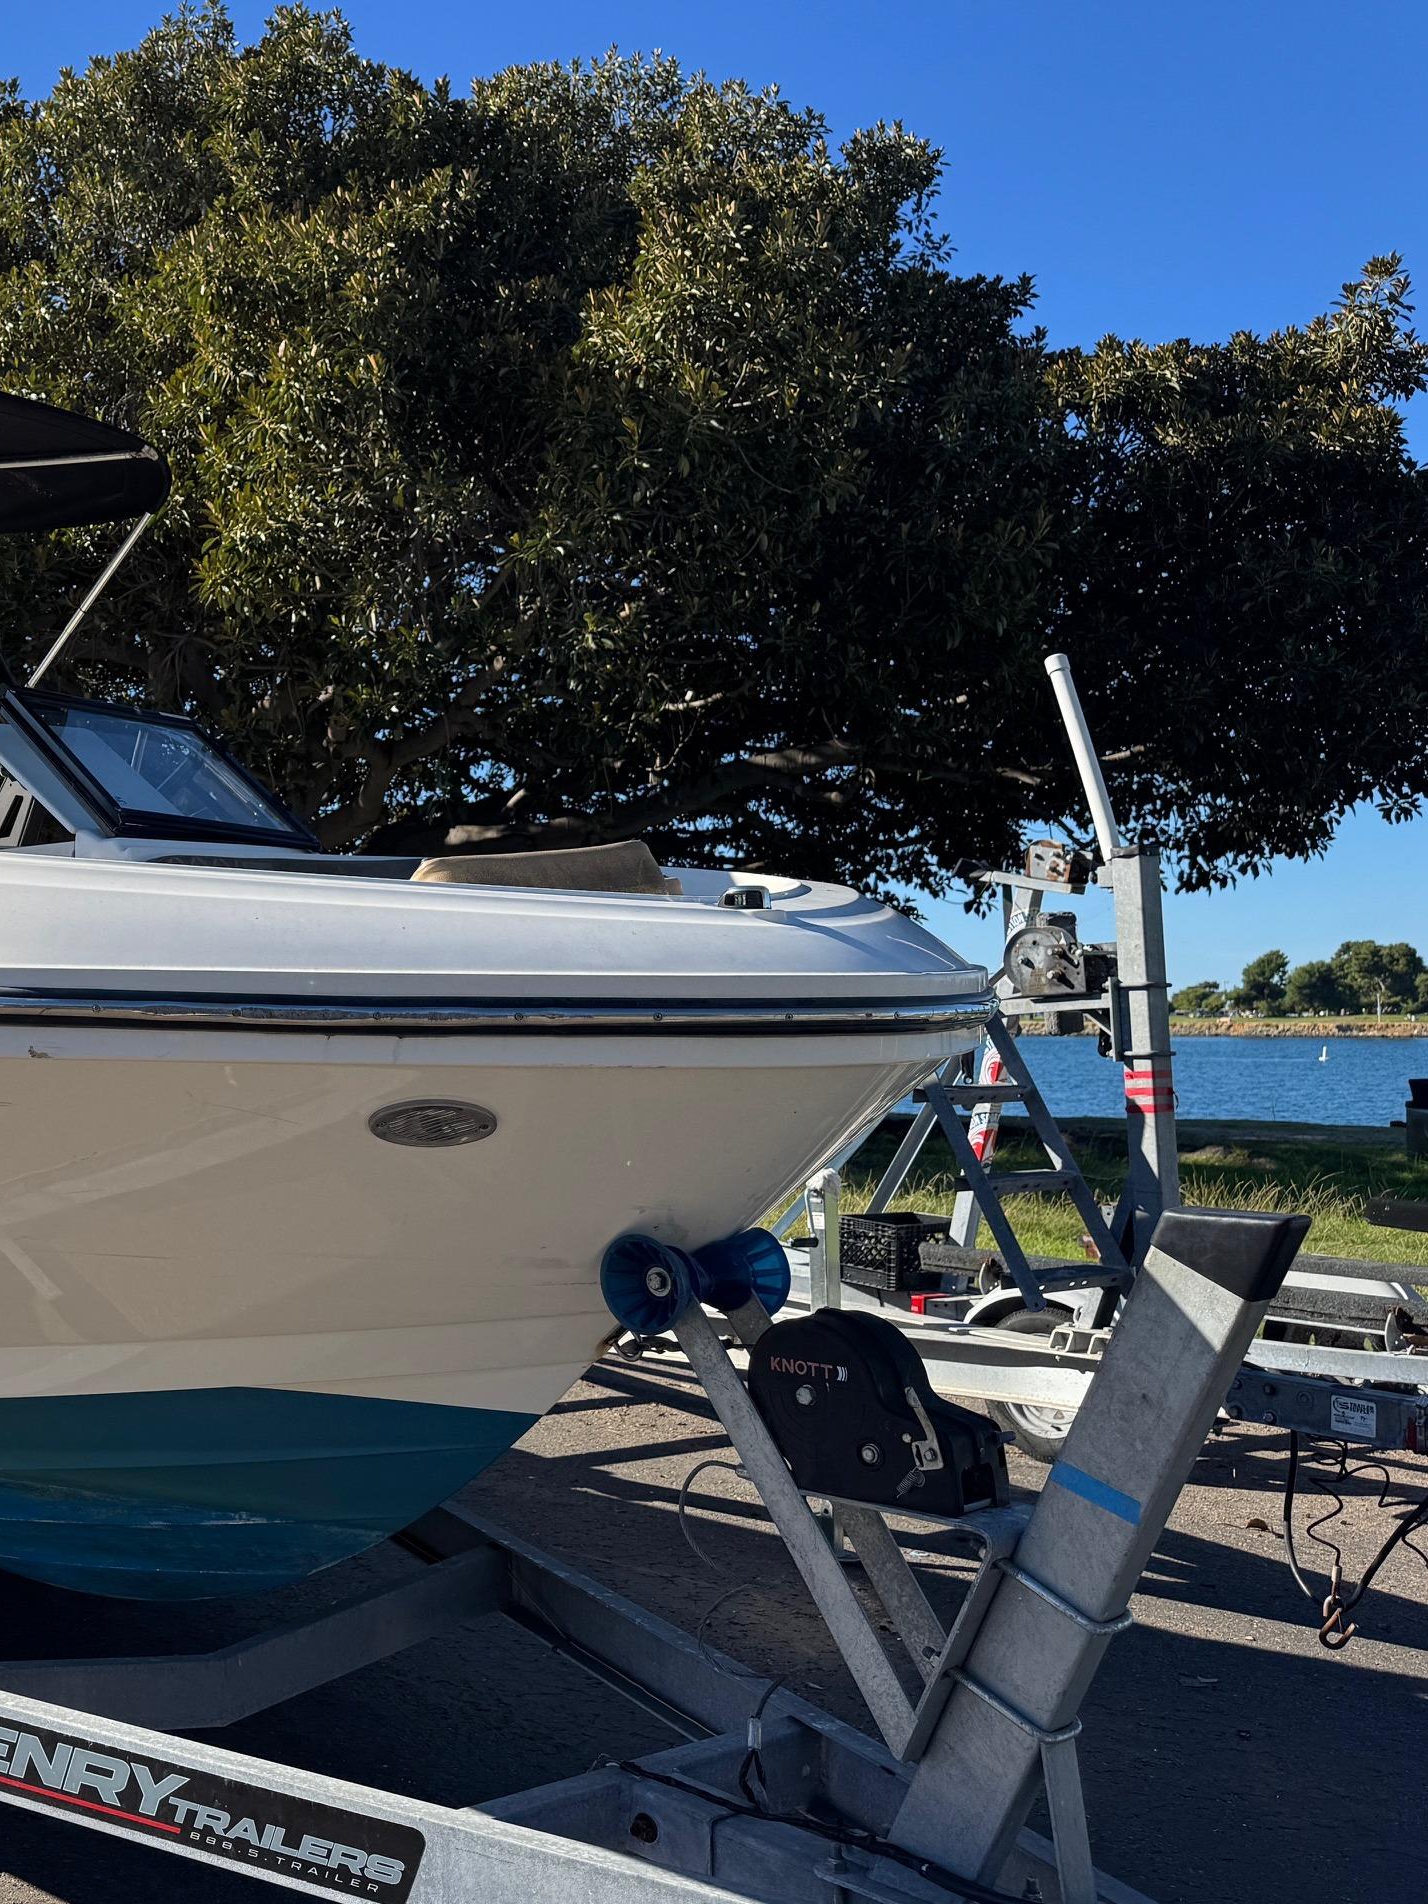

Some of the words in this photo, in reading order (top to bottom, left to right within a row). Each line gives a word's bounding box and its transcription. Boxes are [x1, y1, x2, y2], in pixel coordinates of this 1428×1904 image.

[769, 1355, 833, 1379] KNOTT
[169, 1796, 405, 1885] TRAILERS
[189, 1831, 380, 1893] 888.5.TRAILER
